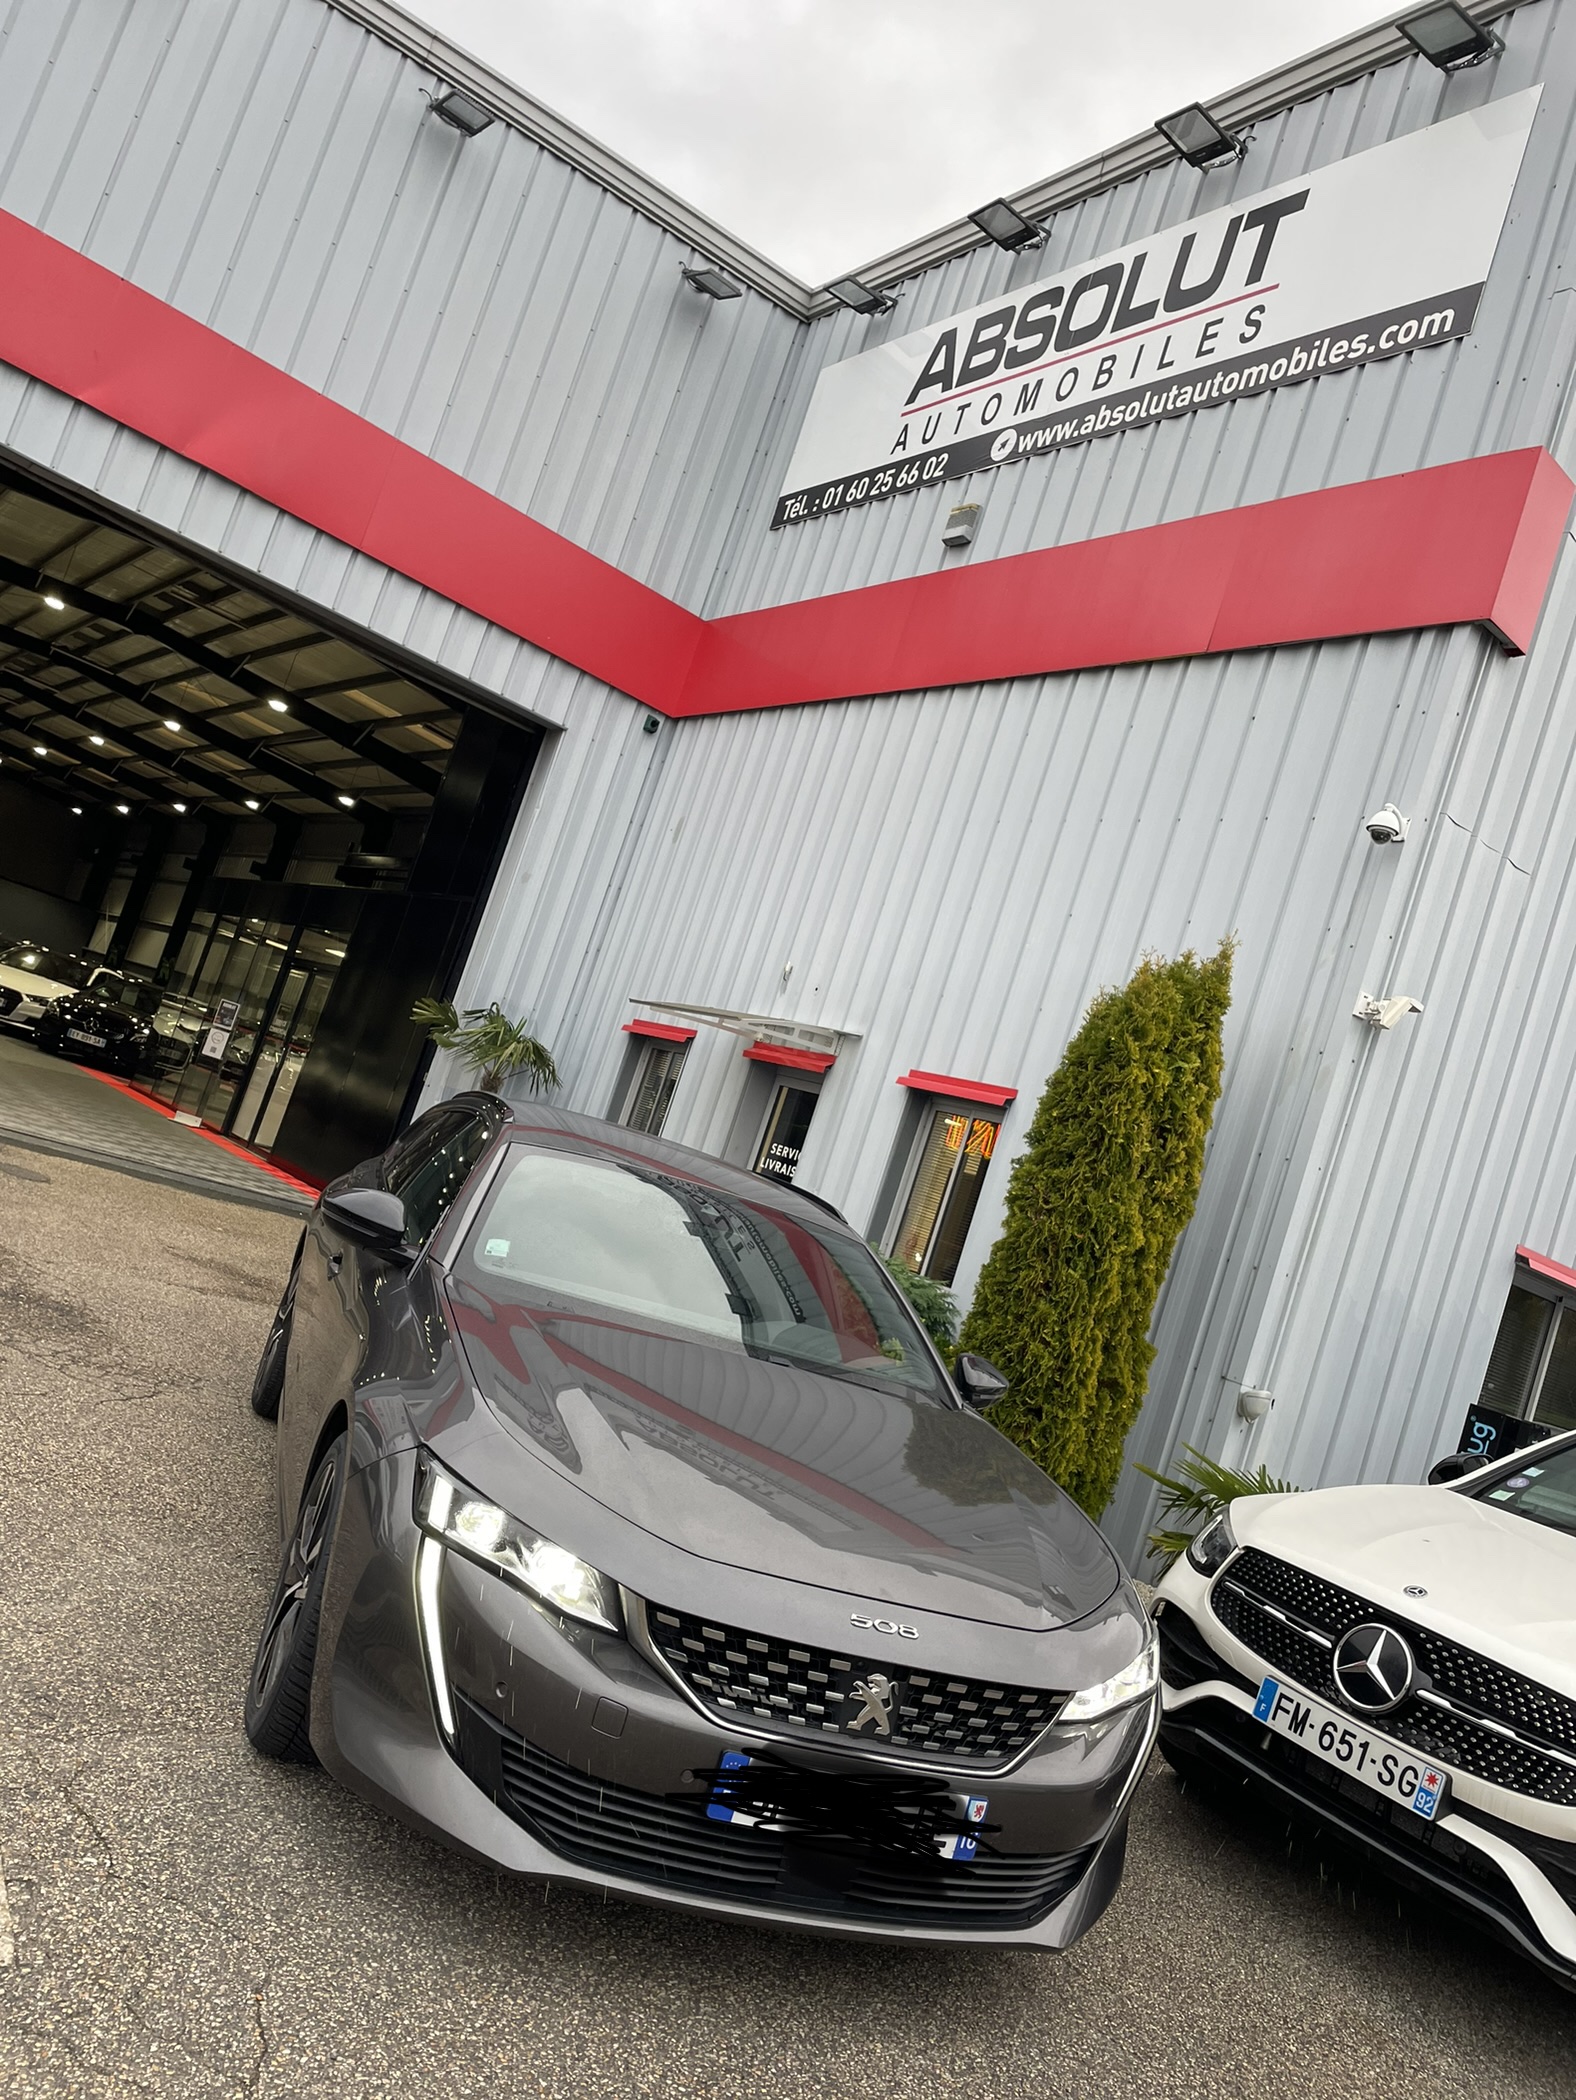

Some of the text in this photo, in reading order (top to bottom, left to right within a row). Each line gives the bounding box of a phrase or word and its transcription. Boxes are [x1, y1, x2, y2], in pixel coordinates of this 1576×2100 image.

[904, 188, 1311, 406] ABSOLUT
[889, 304, 1267, 455] AUTOMOBILES
[1017, 305, 1456, 454] www.absolutautomobiles.com
[782, 494, 808, 521] Tél.
[822, 484, 845, 509] 01
[846, 476, 870, 503] 60
[870, 468, 896, 496] 25
[896, 461, 921, 487] 66
[922, 453, 949, 480] 02
[1462, 1421, 1496, 1454] ug
[850, 1613, 919, 1640] 508
[1259, 1703, 1267, 1712] F
[1271, 1692, 1420, 1798] FM-651-SG
[1415, 1792, 1434, 1814] 92
